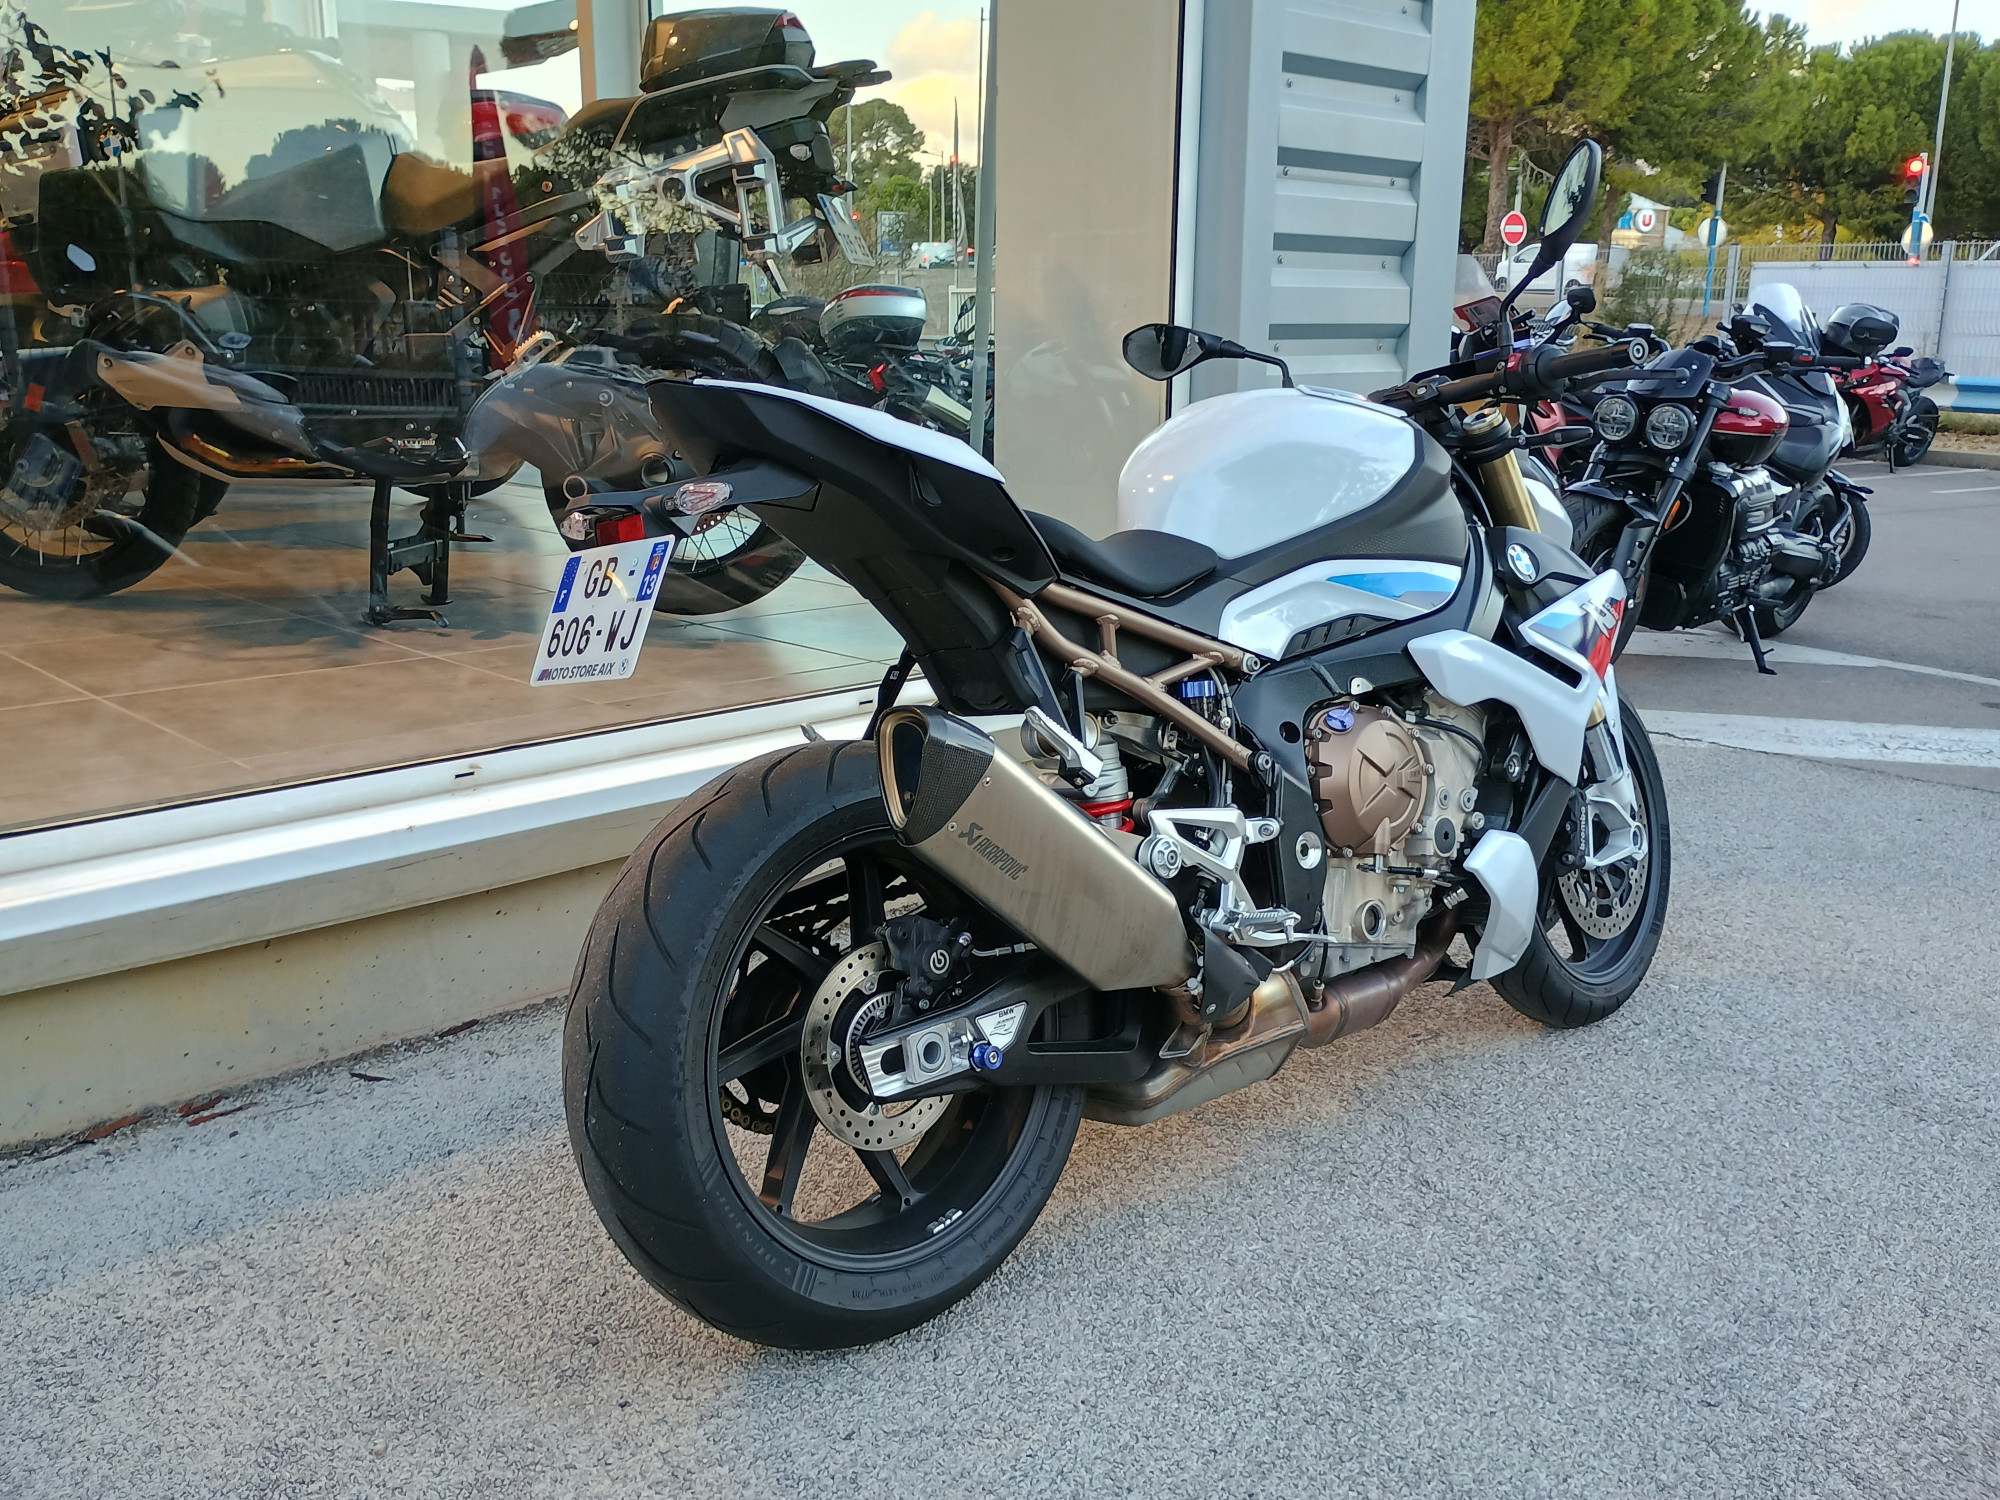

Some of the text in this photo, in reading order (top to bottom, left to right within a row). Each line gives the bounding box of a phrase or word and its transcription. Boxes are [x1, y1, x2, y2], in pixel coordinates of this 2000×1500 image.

[1642, 214, 1653, 227] U
[641, 573, 658, 596] 13
[558, 589, 568, 604] F
[547, 607, 643, 659] 606-WJ
[569, 663, 599, 679] STORE
[596, 661, 616, 676] AIX
[998, 1007, 1015, 1018] BMW
